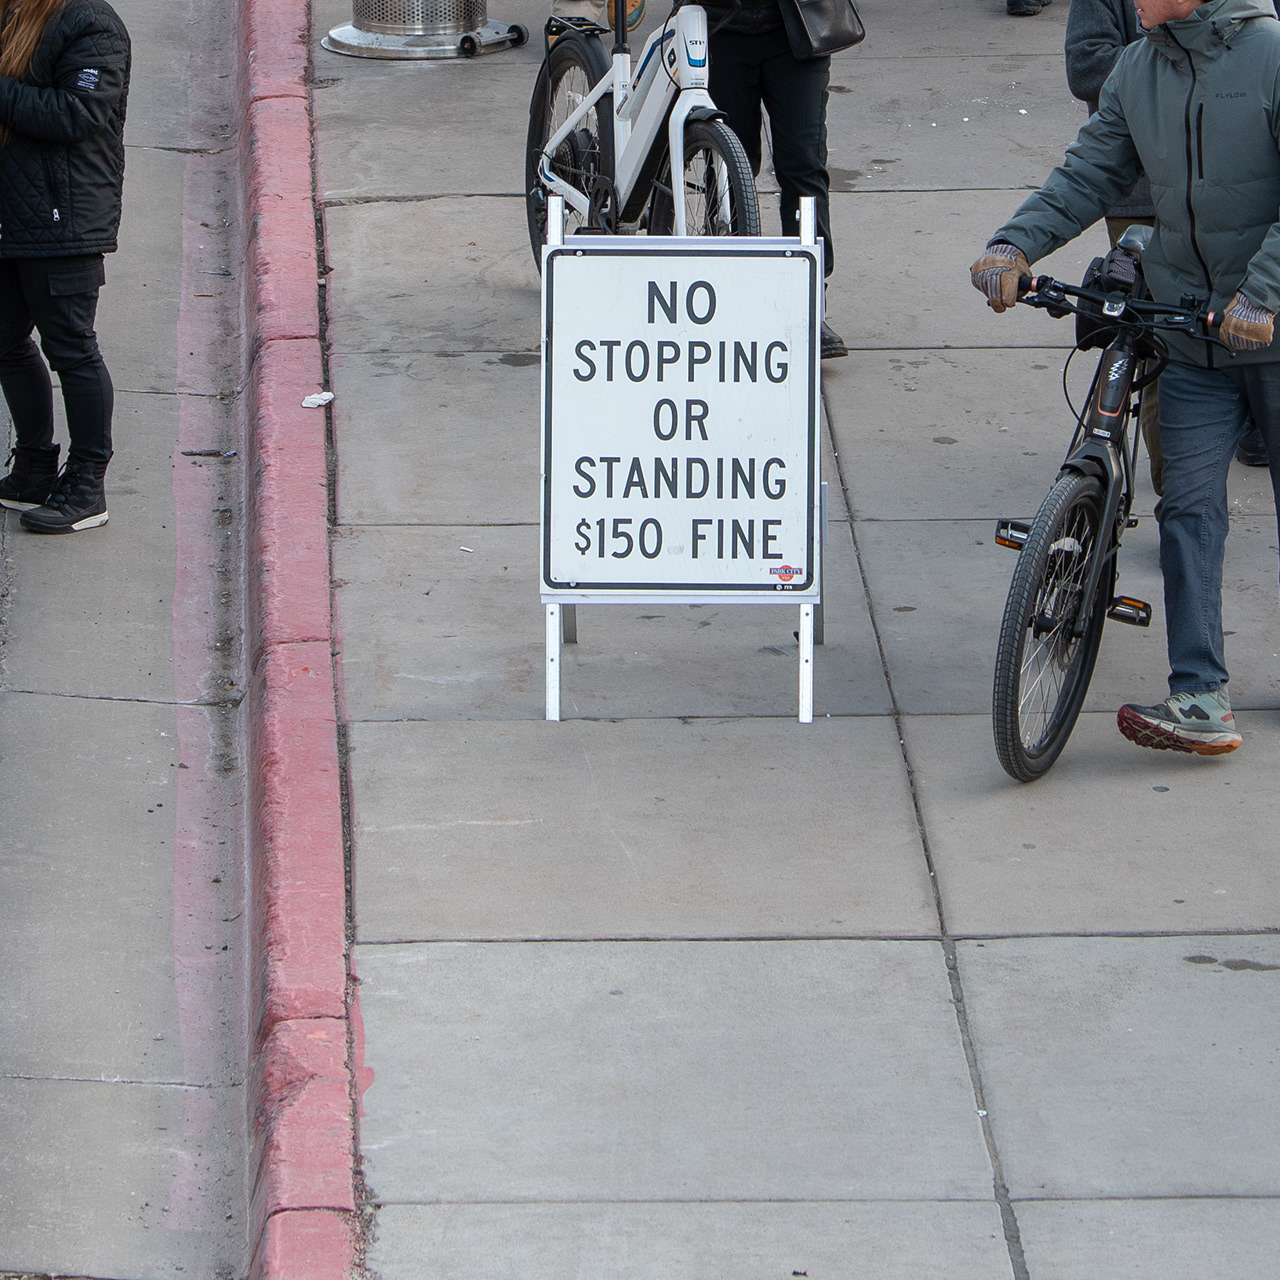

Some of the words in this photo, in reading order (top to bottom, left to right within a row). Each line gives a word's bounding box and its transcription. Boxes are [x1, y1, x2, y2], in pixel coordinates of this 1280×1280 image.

[648, 281, 716, 324] NO
[574, 340, 787, 383] STOPPING
[654, 399, 708, 440] OR
[573, 457, 785, 499] STANDING
[575, 519, 662, 558] $150
[692, 520, 782, 559] FINE
